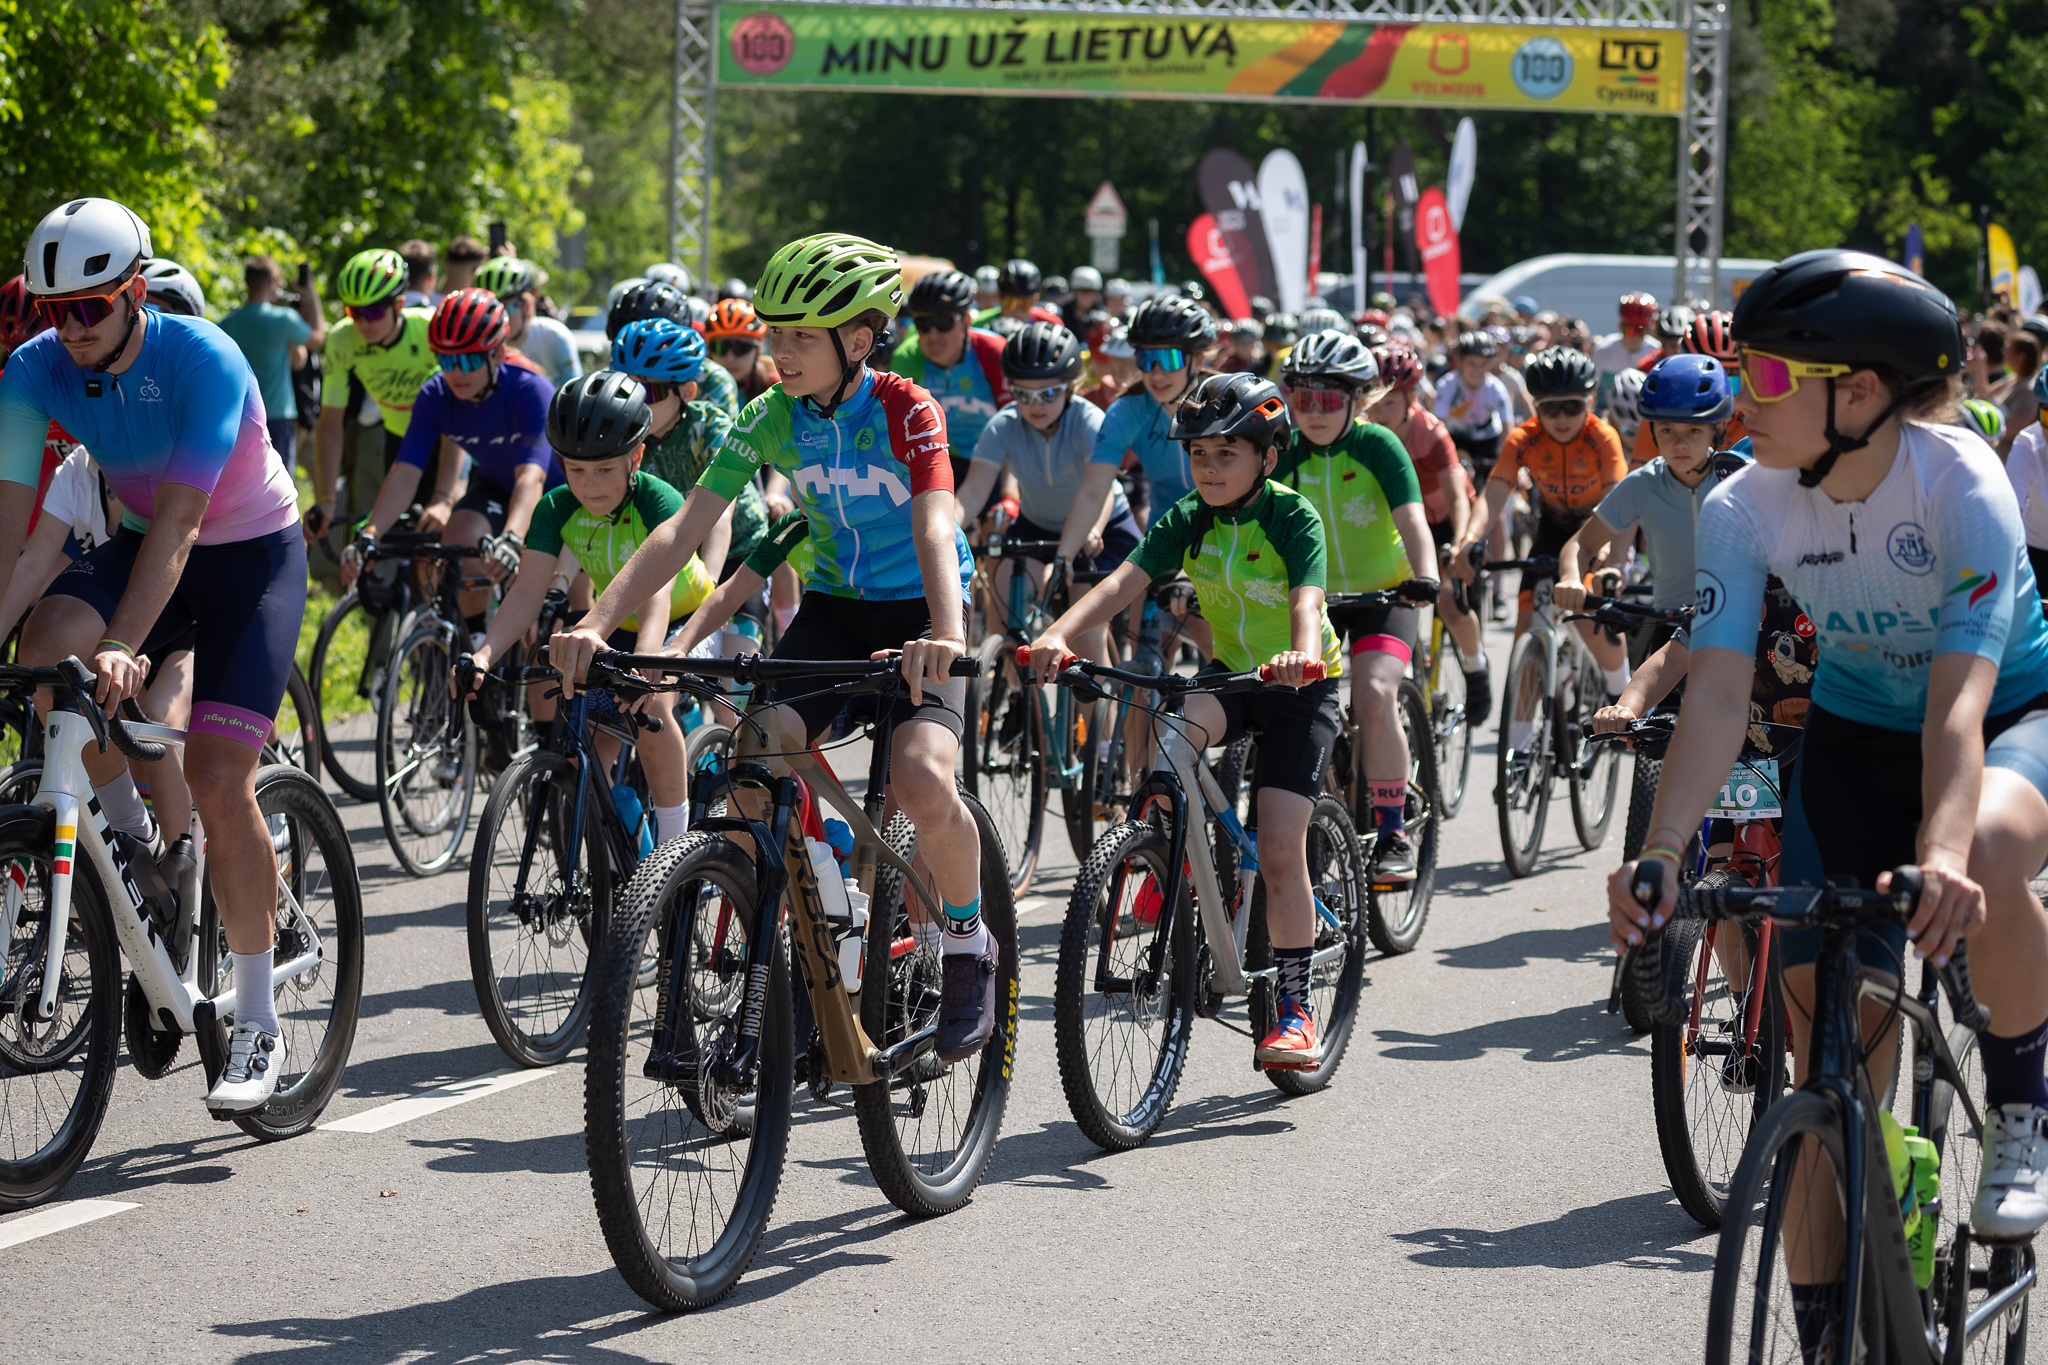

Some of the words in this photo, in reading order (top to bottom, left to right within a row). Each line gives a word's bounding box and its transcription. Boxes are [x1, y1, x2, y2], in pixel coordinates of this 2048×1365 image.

[821, 35, 951, 76] MINU
[967, 18, 1029, 68] UŽ
[1044, 25, 1238, 67] LIETUVĄ
[1599, 39, 1662, 70] LTU
[1520, 54, 1565, 84] 100
[1597, 85, 1658, 104] Cycling
[723, 435, 759, 463] NIUS
[203, 713, 227, 725] legs!
[229, 718, 243, 727] up
[244, 723, 265, 739] Shut
[1720, 783, 1758, 808] 10
[87, 780, 157, 950] TREK
[787, 809, 841, 992] ORBEA
[741, 963, 769, 1038] ROCKSHOX
[1002, 978, 1018, 1079] MAXXIS
[269, 1099, 305, 1118] AEOLUS
[1126, 1108, 1160, 1137] ROCKET
